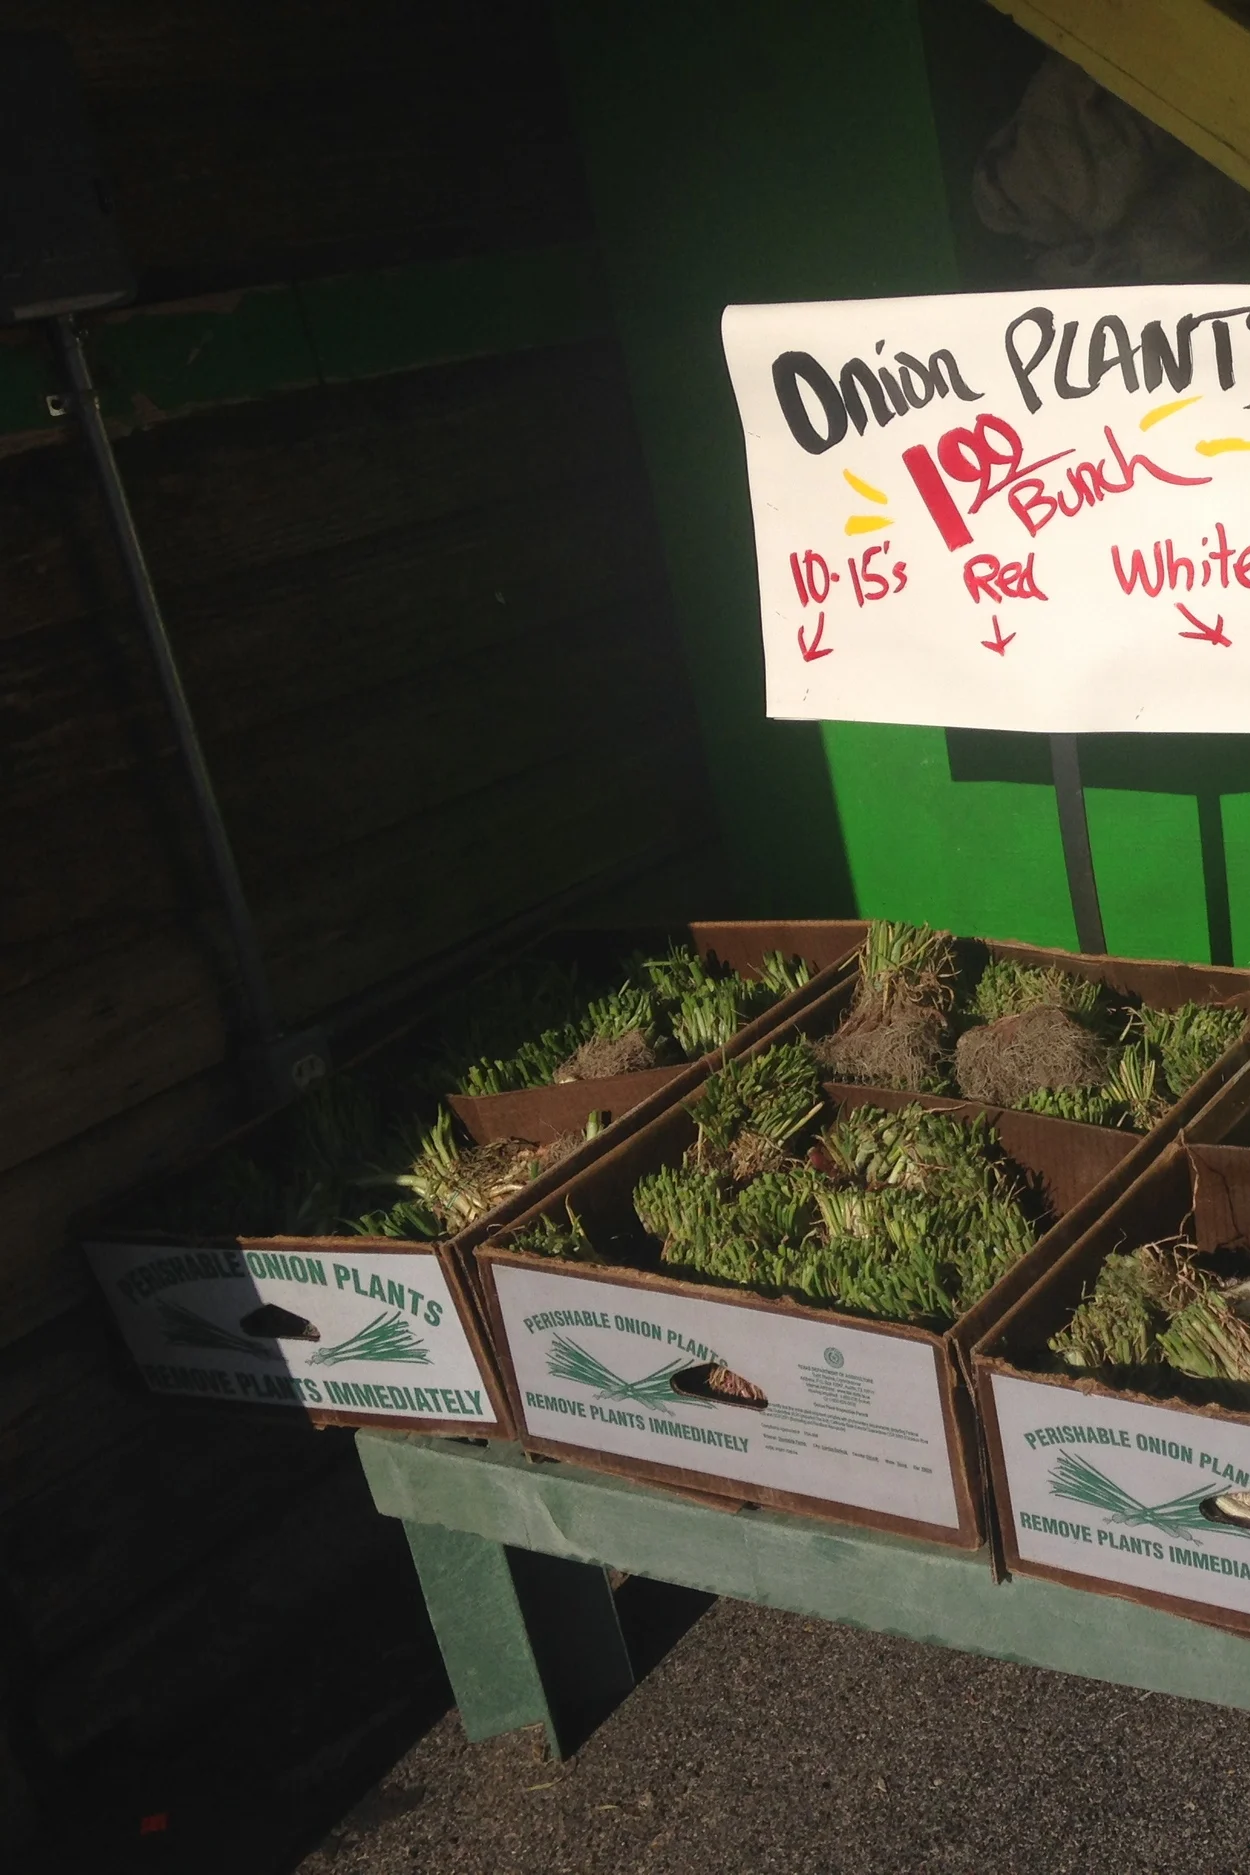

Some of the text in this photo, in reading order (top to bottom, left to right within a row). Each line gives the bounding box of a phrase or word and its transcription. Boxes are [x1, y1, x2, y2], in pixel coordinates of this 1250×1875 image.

[772, 339, 985, 455] Onion
[1008, 425, 1212, 537] Bunch
[962, 552, 1048, 604] Red
[116, 1251, 444, 1328] PERISHABLE ONION PLANTS
[523, 1310, 612, 1334] PERISHABLE
[614, 1315, 662, 1341] ONION
[144, 1364, 484, 1416] REMOVE PLANTS IMMEDIATELY
[525, 1391, 587, 1418] REMOVE
[590, 1405, 645, 1431] PLANTS
[649, 1417, 749, 1453] IMMEDIATELY
[1024, 1425, 1132, 1451] PERISHABLE
[1136, 1433, 1193, 1464] ONION
[1019, 1511, 1092, 1543] REMOVE
[1097, 1529, 1164, 1560] PLANTS
